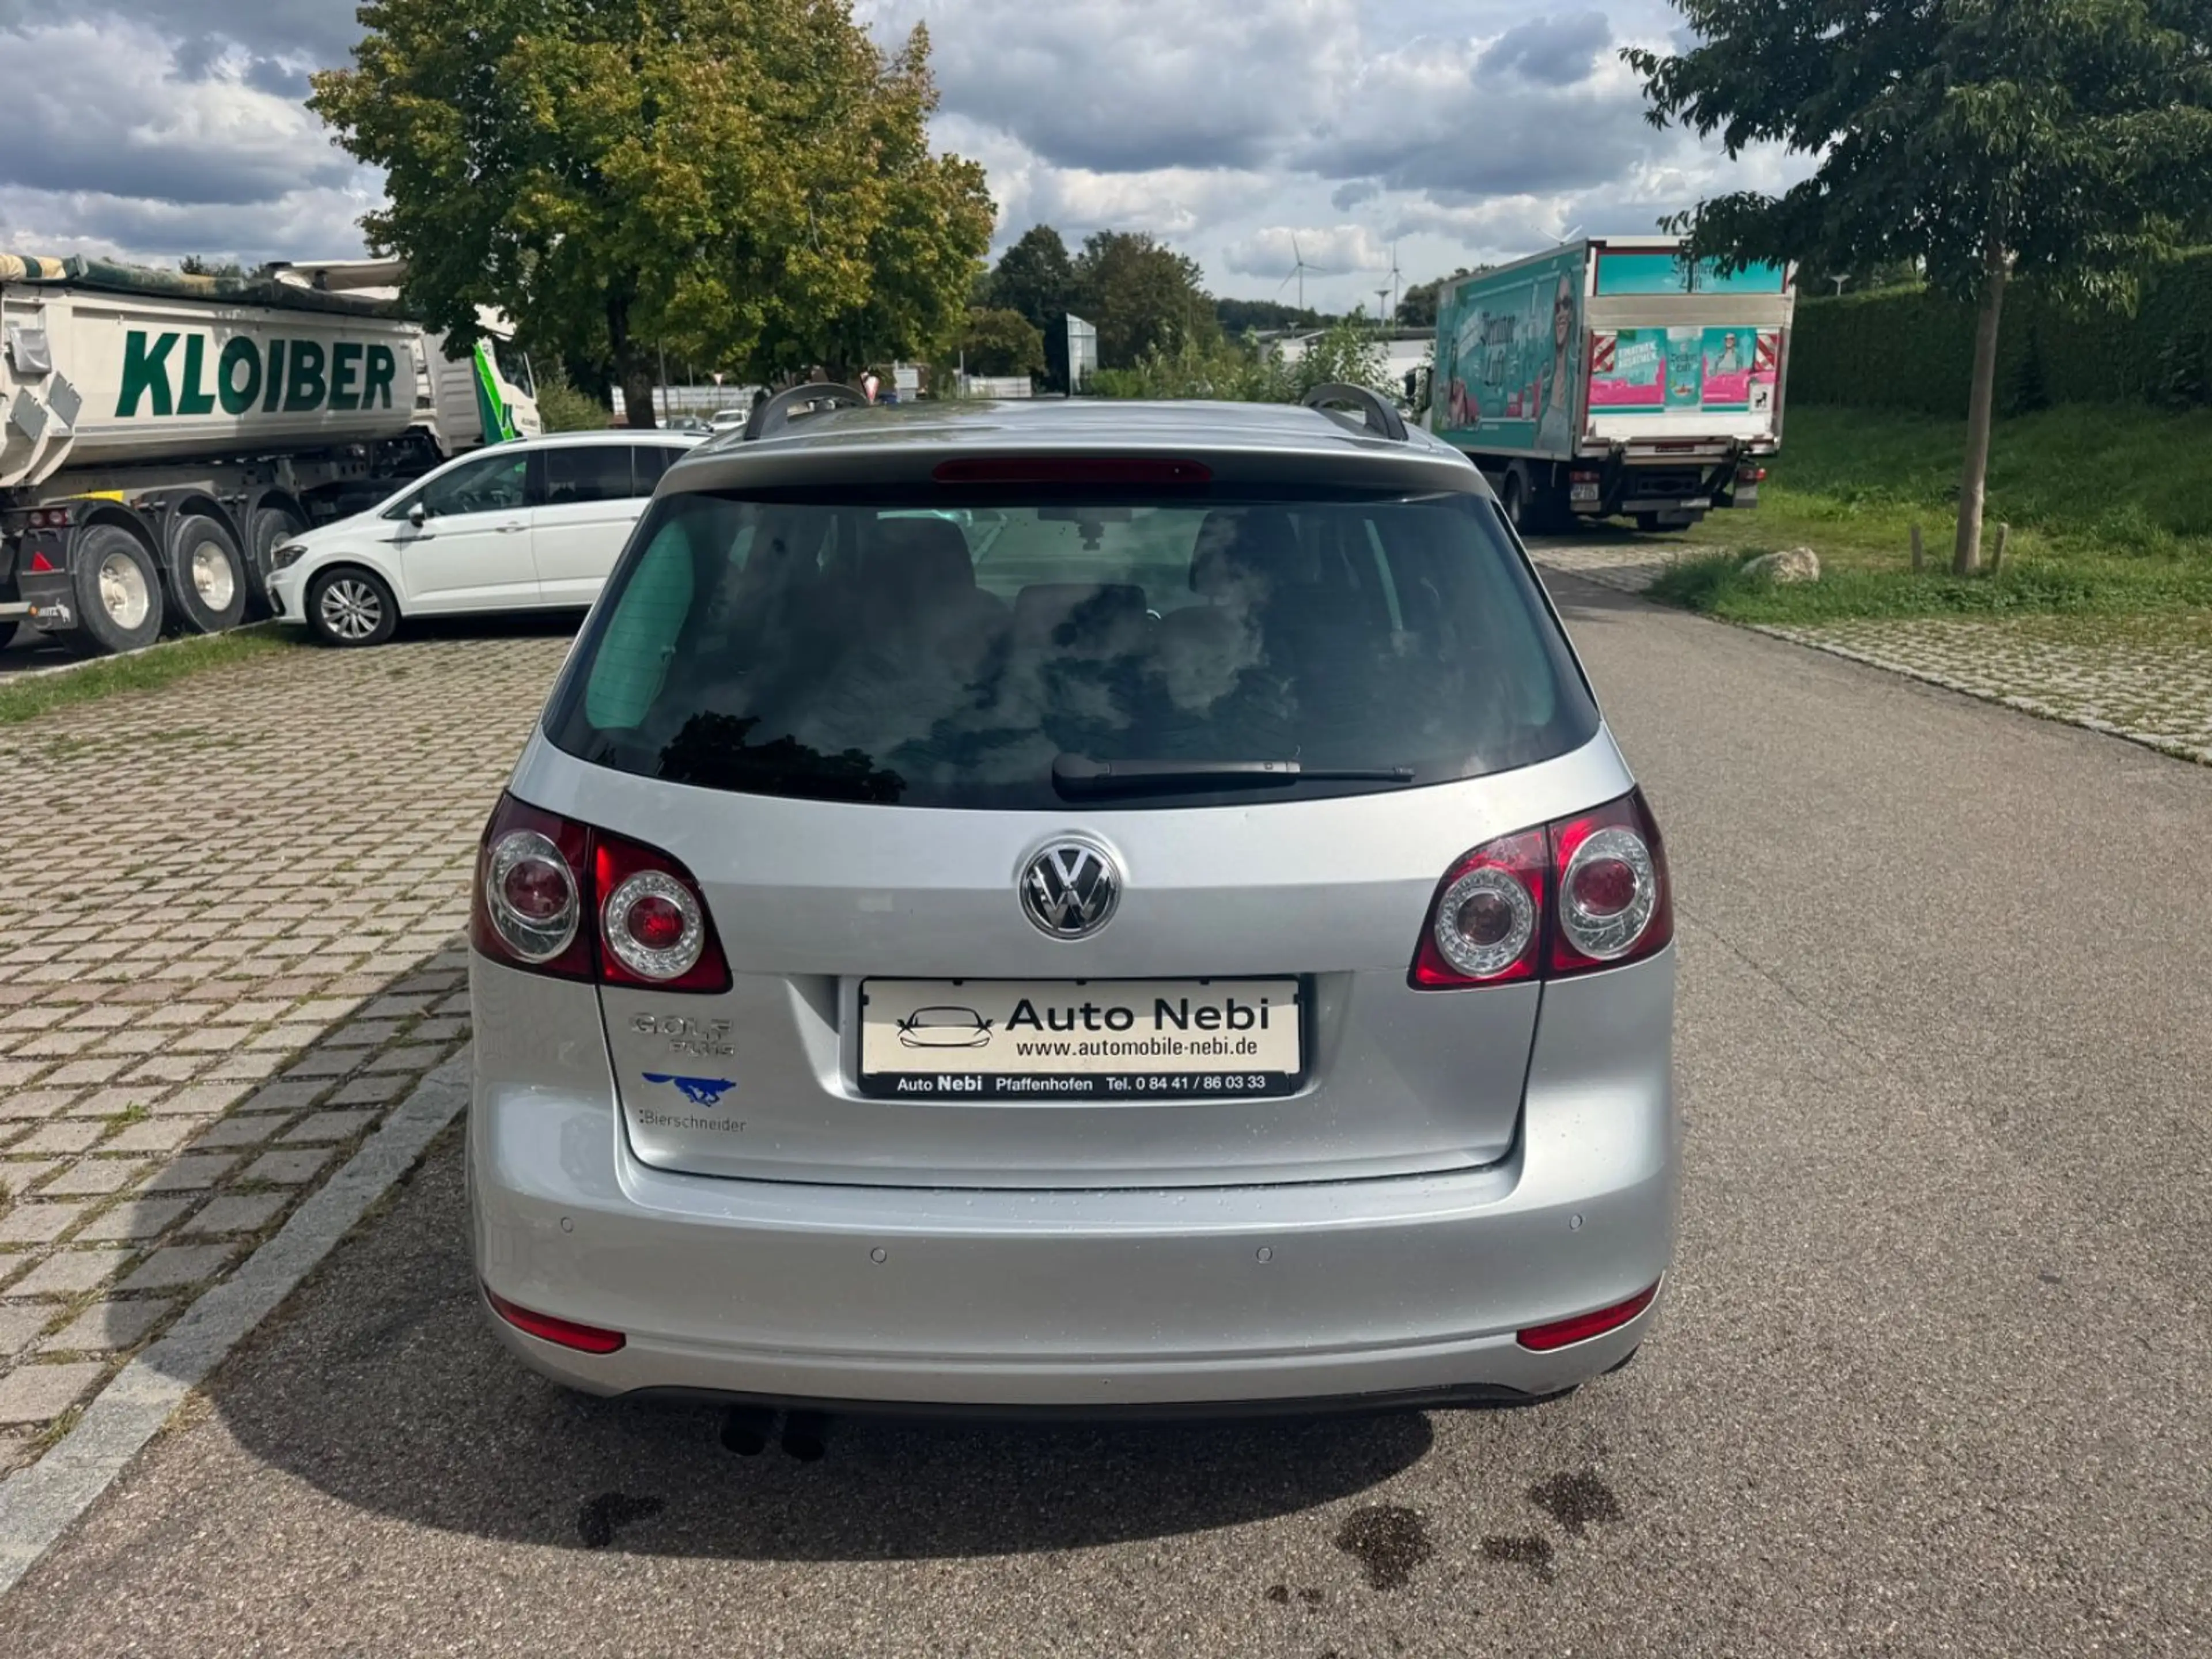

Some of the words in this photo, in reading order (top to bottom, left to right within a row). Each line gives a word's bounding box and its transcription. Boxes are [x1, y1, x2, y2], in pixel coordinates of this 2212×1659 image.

[115, 330, 396, 418] KLOIBER
[1024, 842, 1116, 935] VW
[630, 1012, 733, 1039] GOLF
[1005, 998, 1134, 1031] Auto
[1154, 998, 1269, 1030] Nebi
[1016, 1037, 1258, 1056] www.automobile-nebi.de
[897, 1078, 933, 1091] Auto
[937, 1075, 983, 1092] Nebi
[995, 1077, 1093, 1091] Pfaffenhofen
[1106, 1077, 1132, 1090] Tel.
[1135, 1077, 1145, 1090] 0
[1149, 1077, 1168, 1090] 84
[1171, 1077, 1188, 1090] 41
[1192, 1076, 1200, 1090] /
[1203, 1076, 1221, 1089] 86
[1225, 1076, 1244, 1089] 03
[1247, 1075, 1266, 1089] 33
